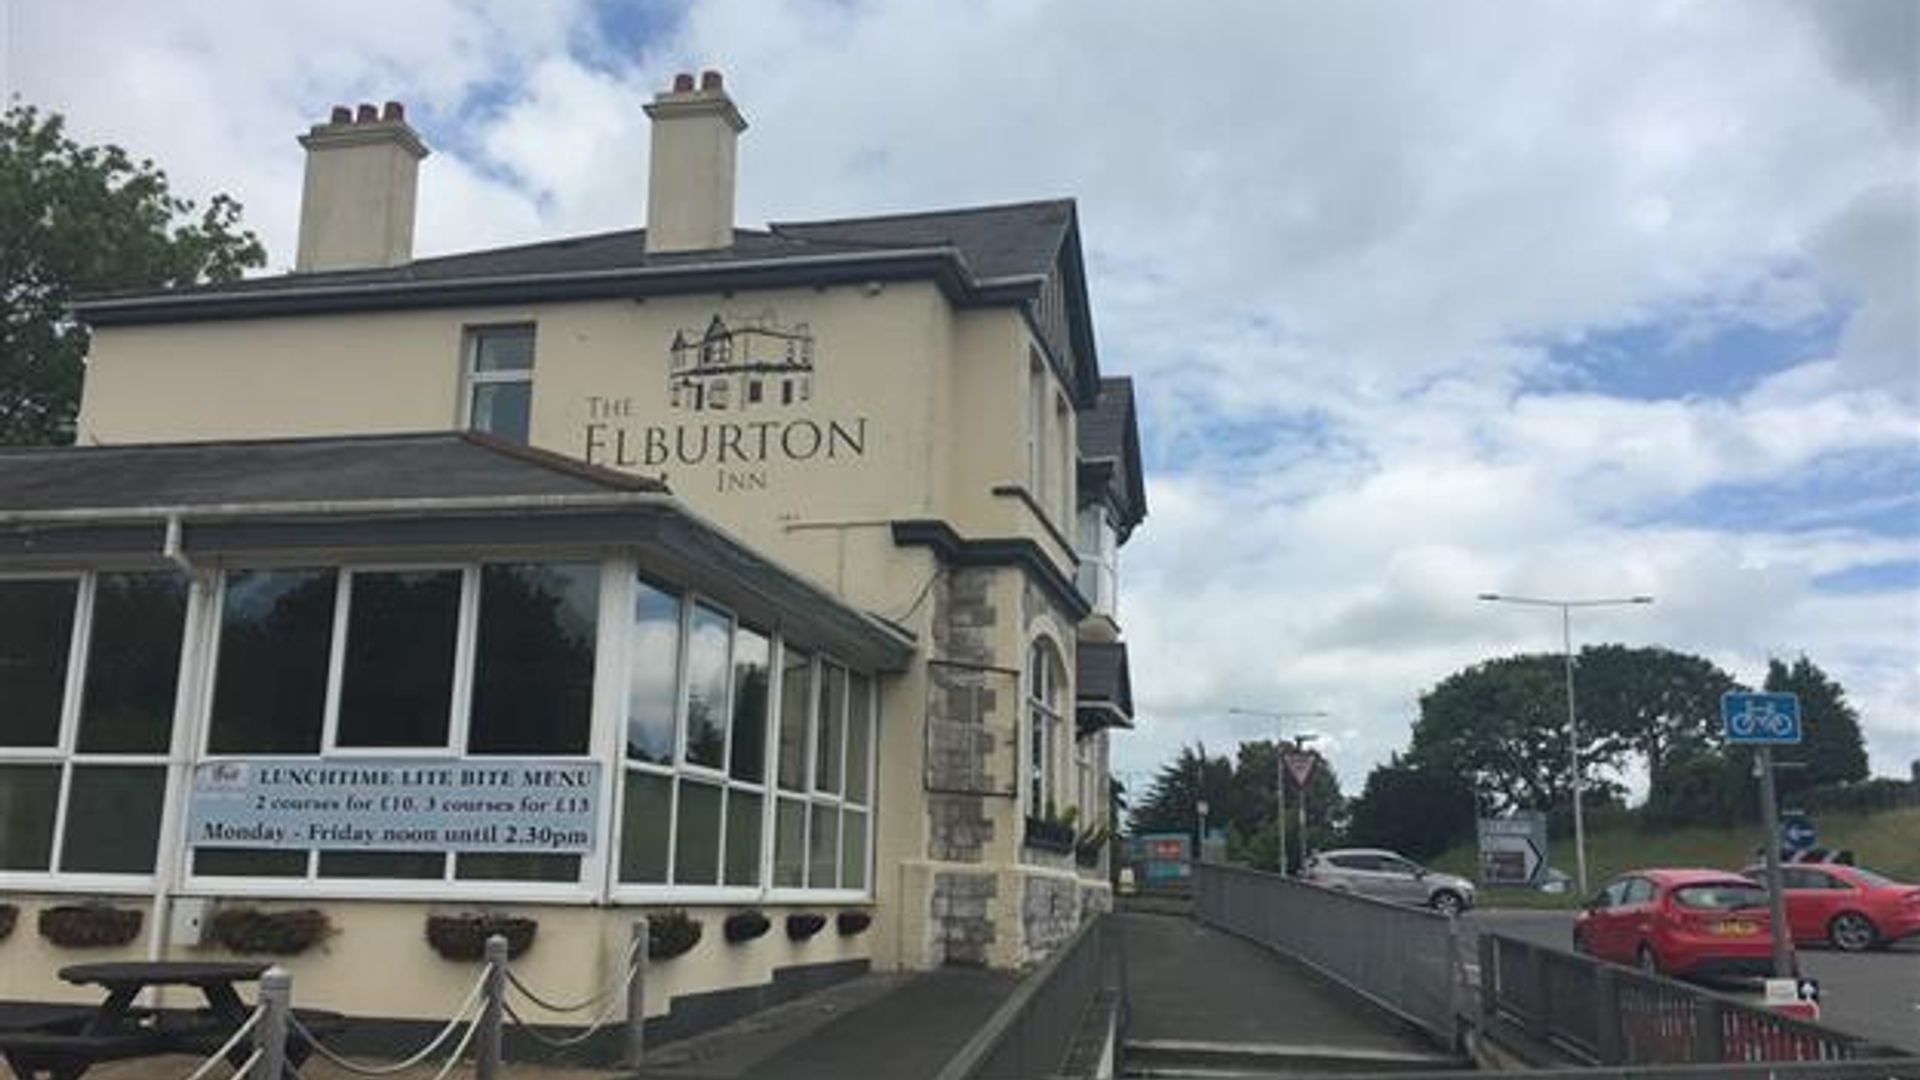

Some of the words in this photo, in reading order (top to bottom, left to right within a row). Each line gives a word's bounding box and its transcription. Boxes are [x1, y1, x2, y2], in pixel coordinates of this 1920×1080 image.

[584, 395, 640, 418] THE
[586, 417, 868, 467] ELBURTON
[717, 468, 768, 492] INN
[259, 768, 395, 786] LUNCHTIME
[402, 770, 453, 786] LITE
[461, 770, 514, 787] BITE
[522, 770, 592, 788] MENU
[255, 795, 267, 810] 2
[270, 798, 340, 810] courses
[346, 794, 373, 811] for
[441, 799, 515, 813] courses
[519, 796, 550, 813] for
[203, 822, 285, 844] Monday
[308, 823, 374, 846] Friday
[383, 828, 437, 843] noon
[444, 825, 497, 843] until
[504, 825, 588, 848] 2.30pm
